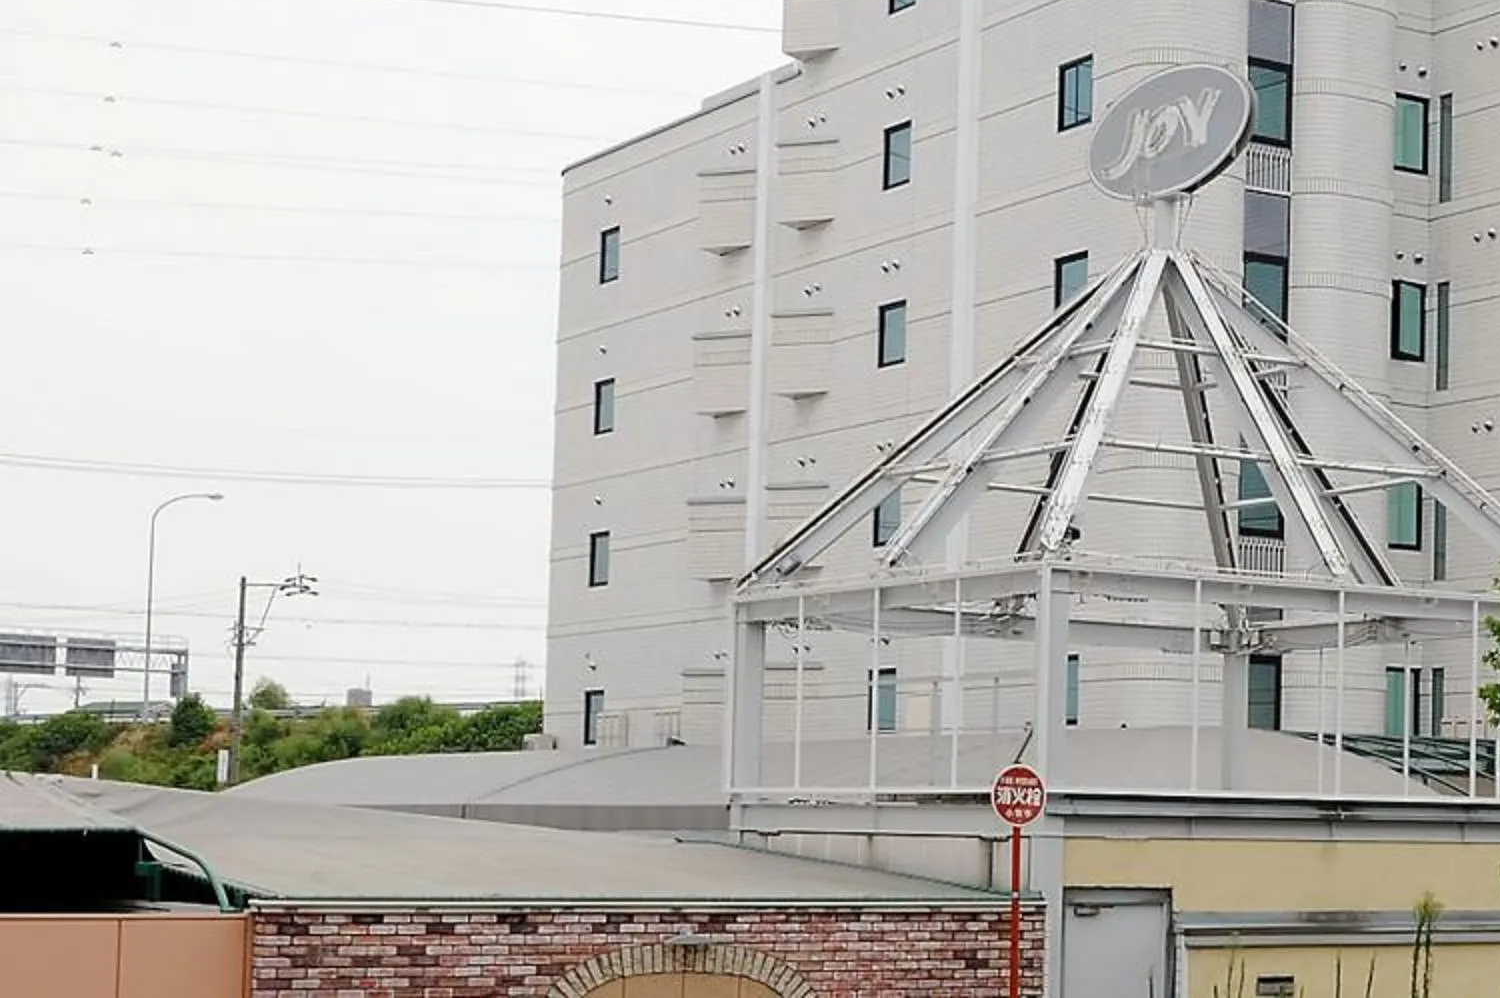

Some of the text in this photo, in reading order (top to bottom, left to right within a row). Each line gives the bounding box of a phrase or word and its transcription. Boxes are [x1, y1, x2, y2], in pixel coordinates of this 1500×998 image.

[1100, 86, 1222, 181] JOY
[996, 785, 1042, 807] 消火栓
